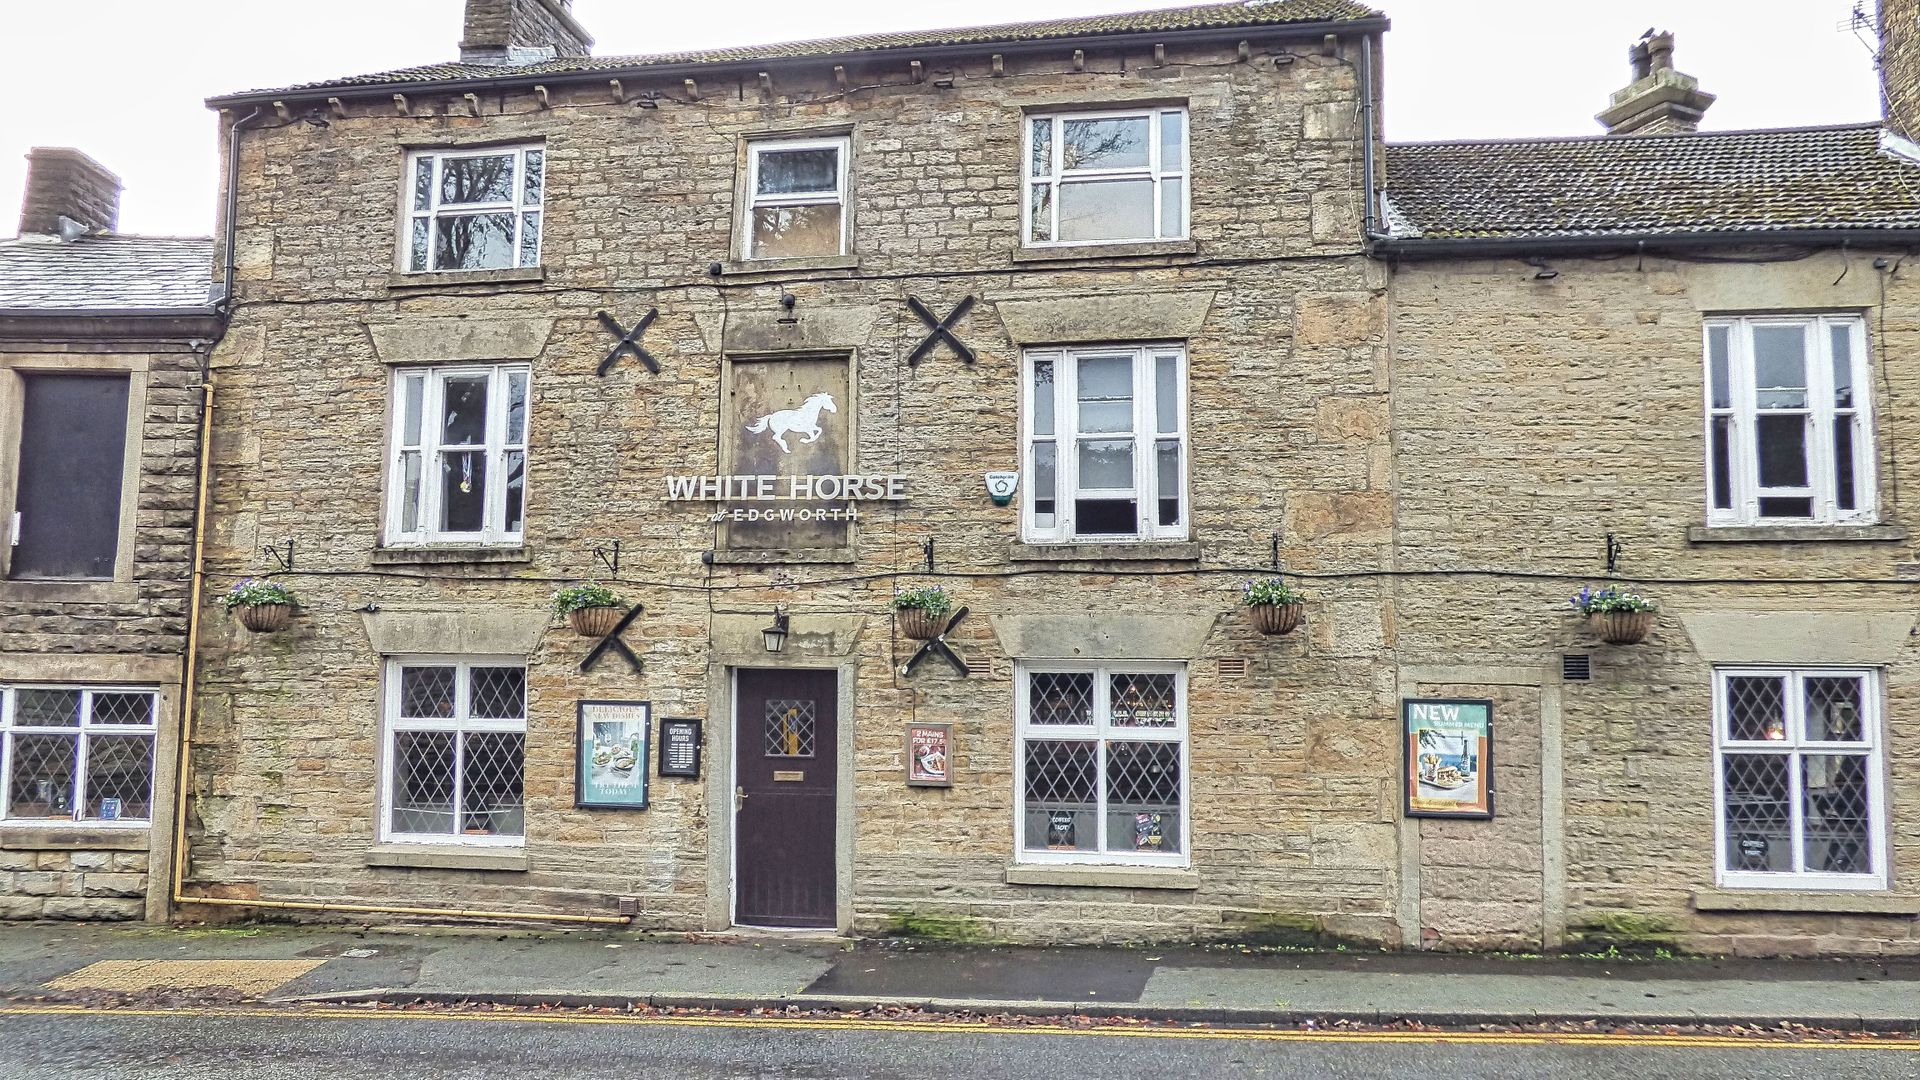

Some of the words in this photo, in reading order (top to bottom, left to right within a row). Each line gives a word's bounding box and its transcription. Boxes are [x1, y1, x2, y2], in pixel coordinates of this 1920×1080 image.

[667, 474, 776, 501] WHITE
[791, 474, 907, 500] HORSE
[711, 509, 726, 522] at
[734, 508, 857, 521] EDGWORTH
[1413, 704, 1460, 721] NEW
